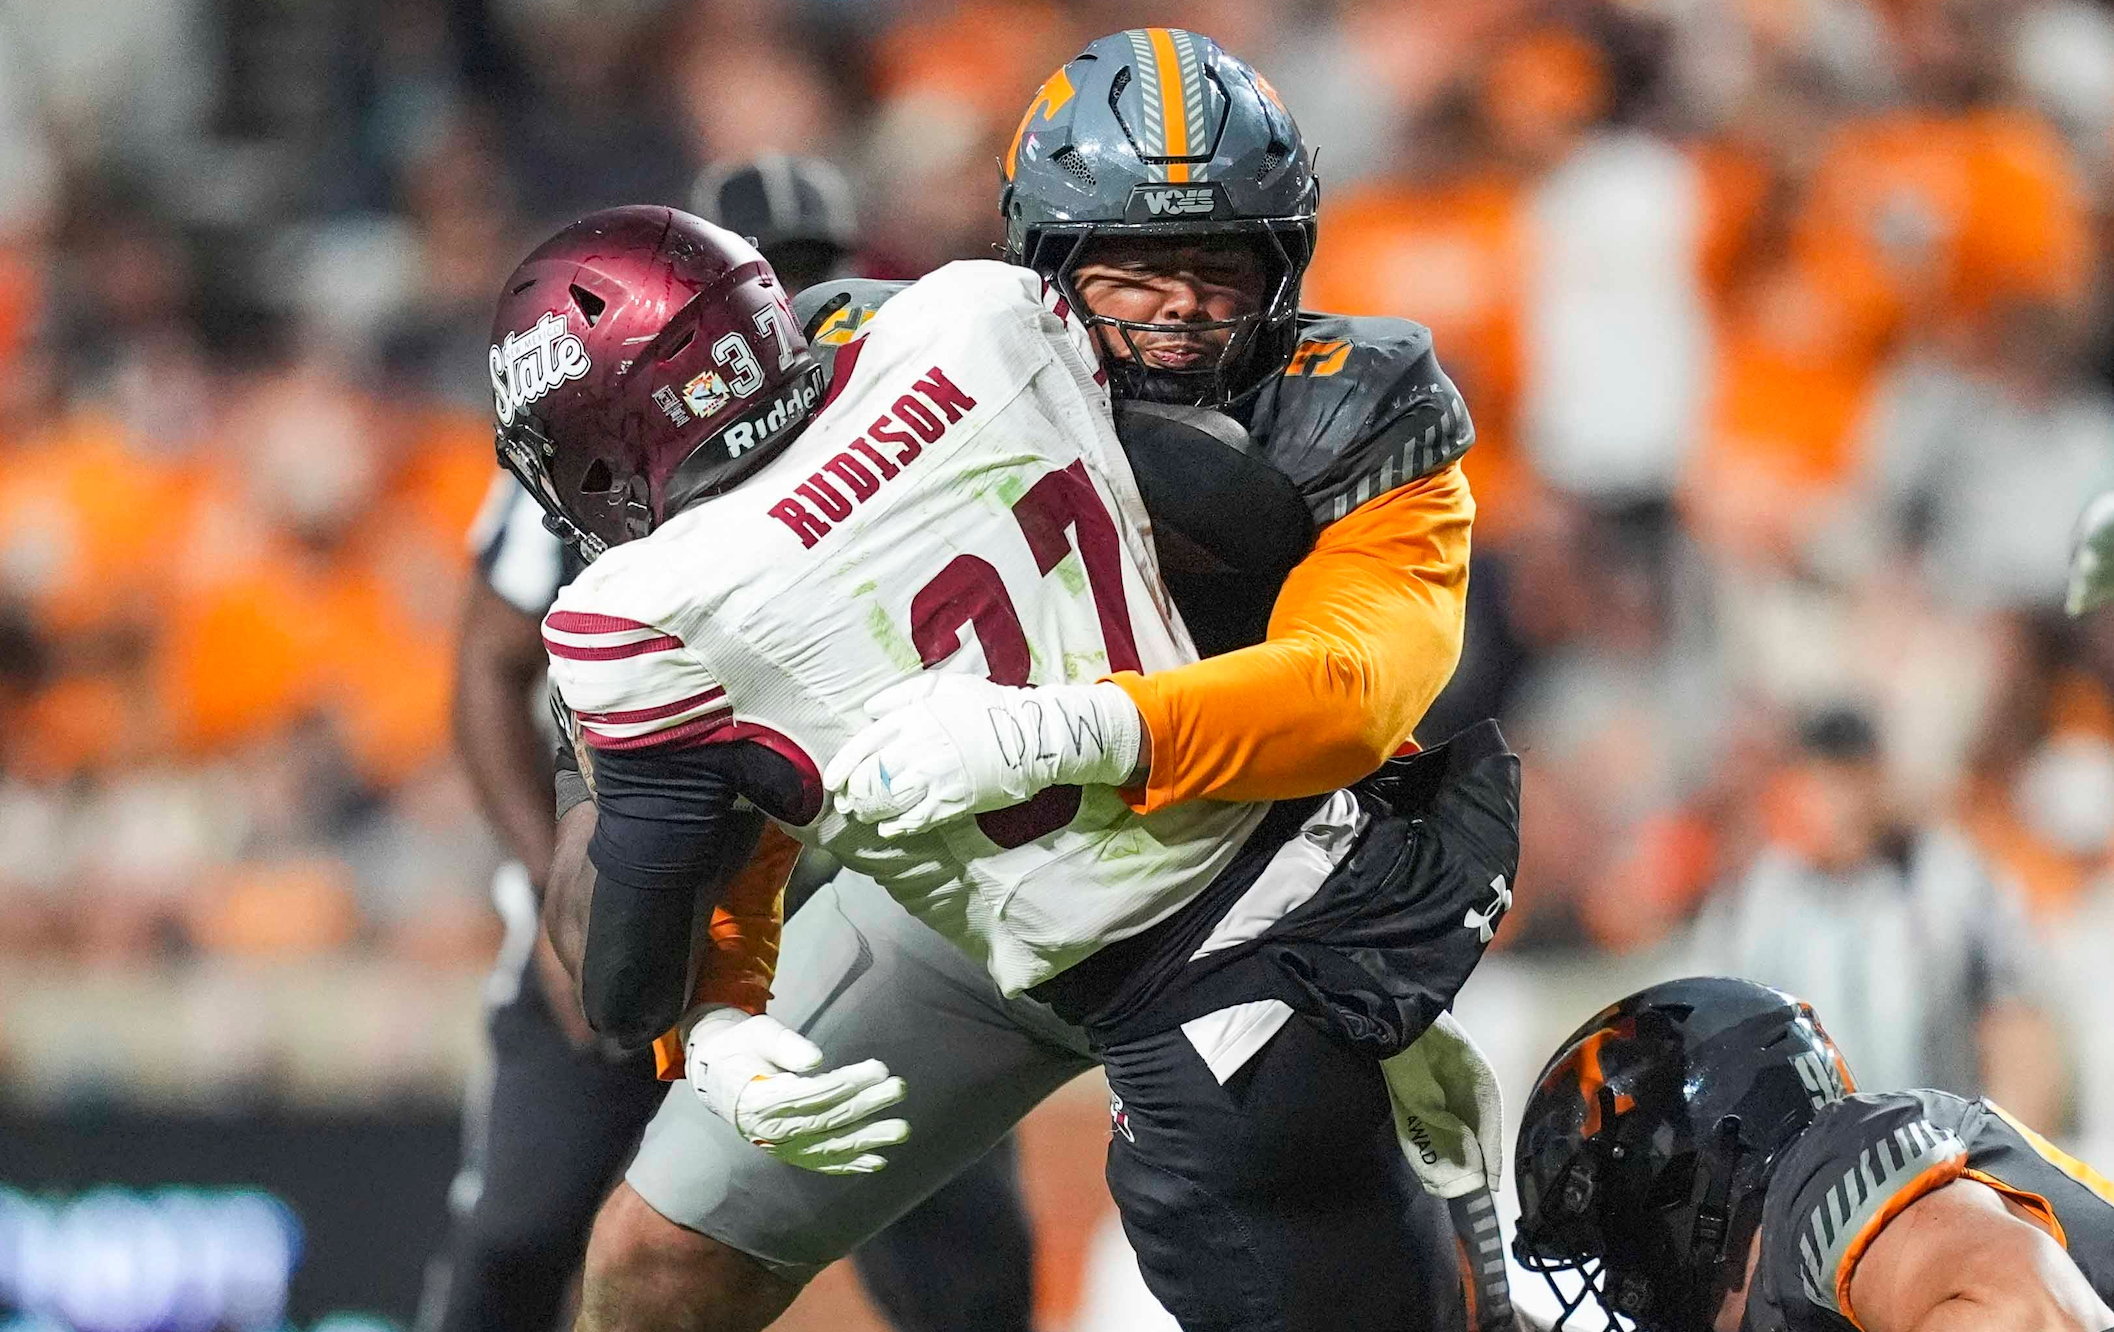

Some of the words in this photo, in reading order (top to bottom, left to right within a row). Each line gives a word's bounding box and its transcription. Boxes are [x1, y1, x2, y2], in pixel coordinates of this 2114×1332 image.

[489, 312, 591, 426] State
[506, 345, 521, 359] NEW
[524, 323, 562, 349] MEXICO
[711, 302, 795, 399] 37
[723, 367, 824, 459] Riddell
[767, 366, 977, 550] RUDISON
[1406, 1115, 1438, 1165] AWAD
